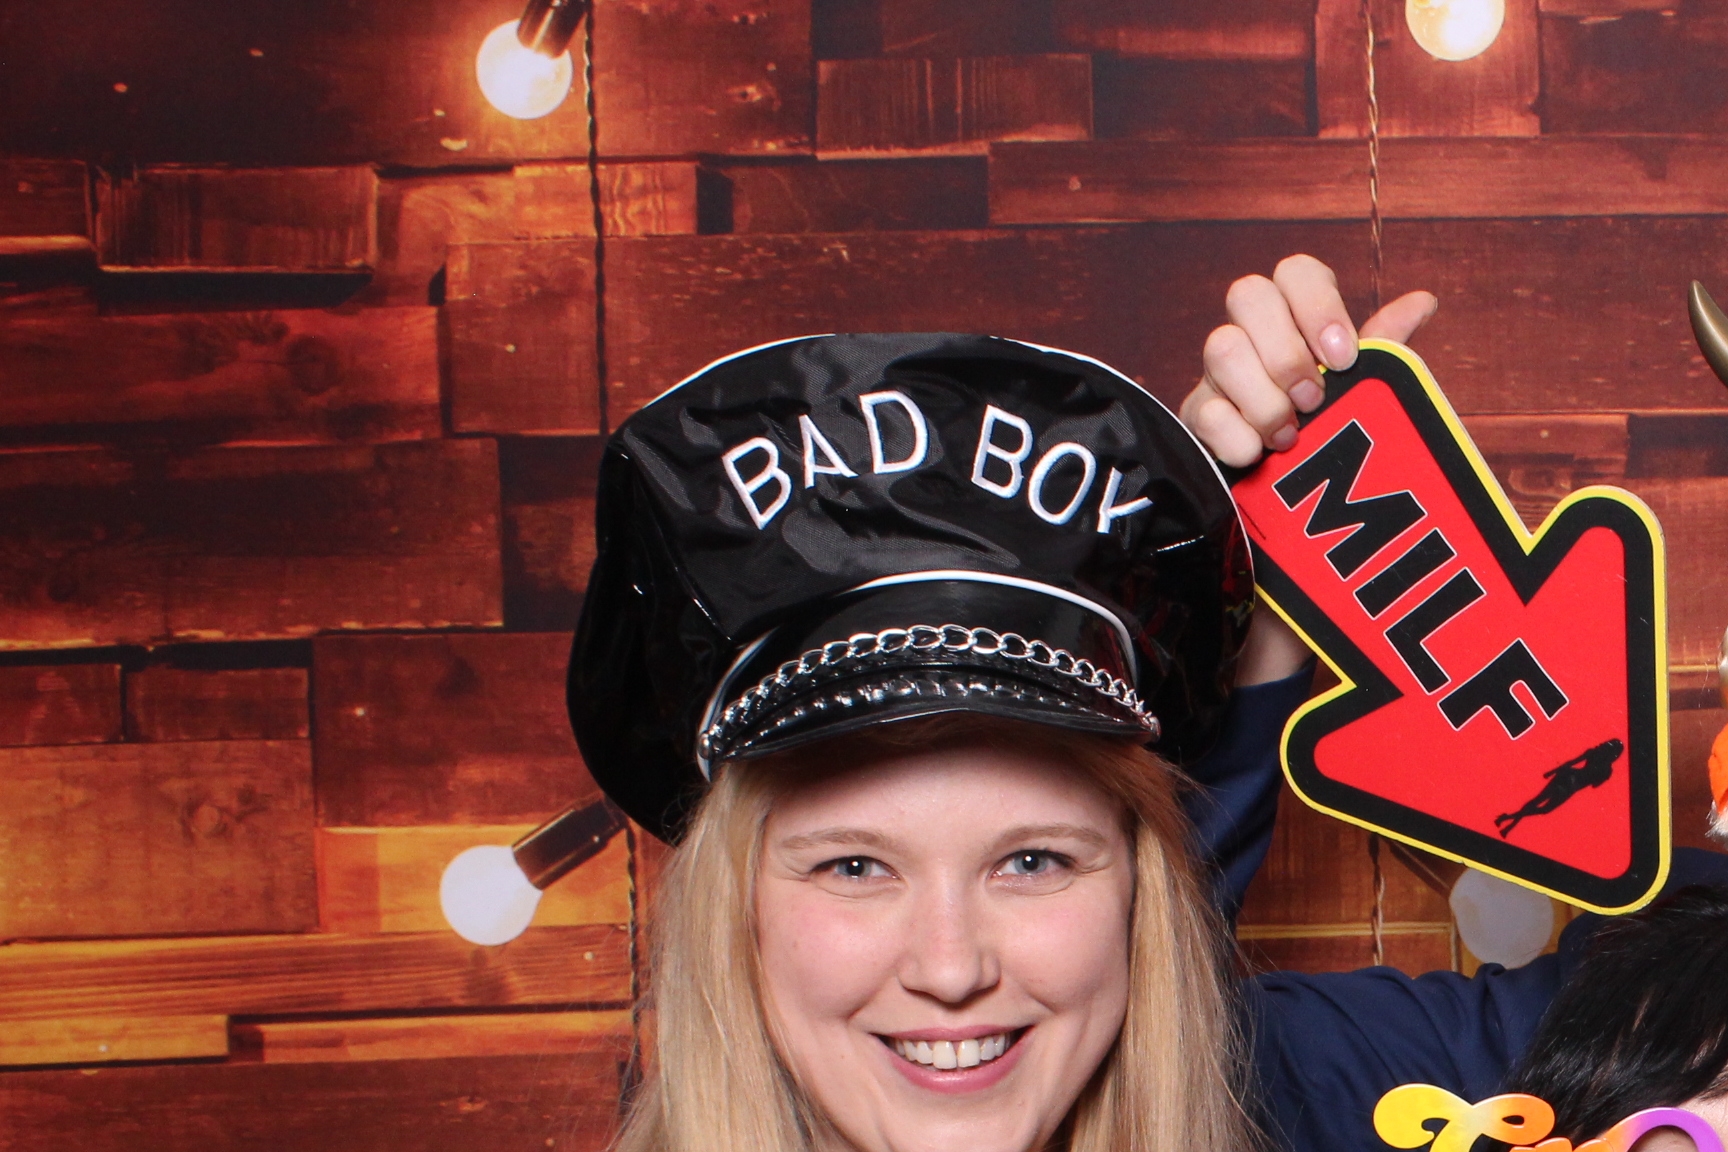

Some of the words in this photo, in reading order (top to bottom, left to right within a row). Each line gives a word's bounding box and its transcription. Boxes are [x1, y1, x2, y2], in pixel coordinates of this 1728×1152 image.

[721, 390, 928, 530] BAD
[970, 404, 1154, 534] BOY
[1272, 418, 1570, 740] MILF
